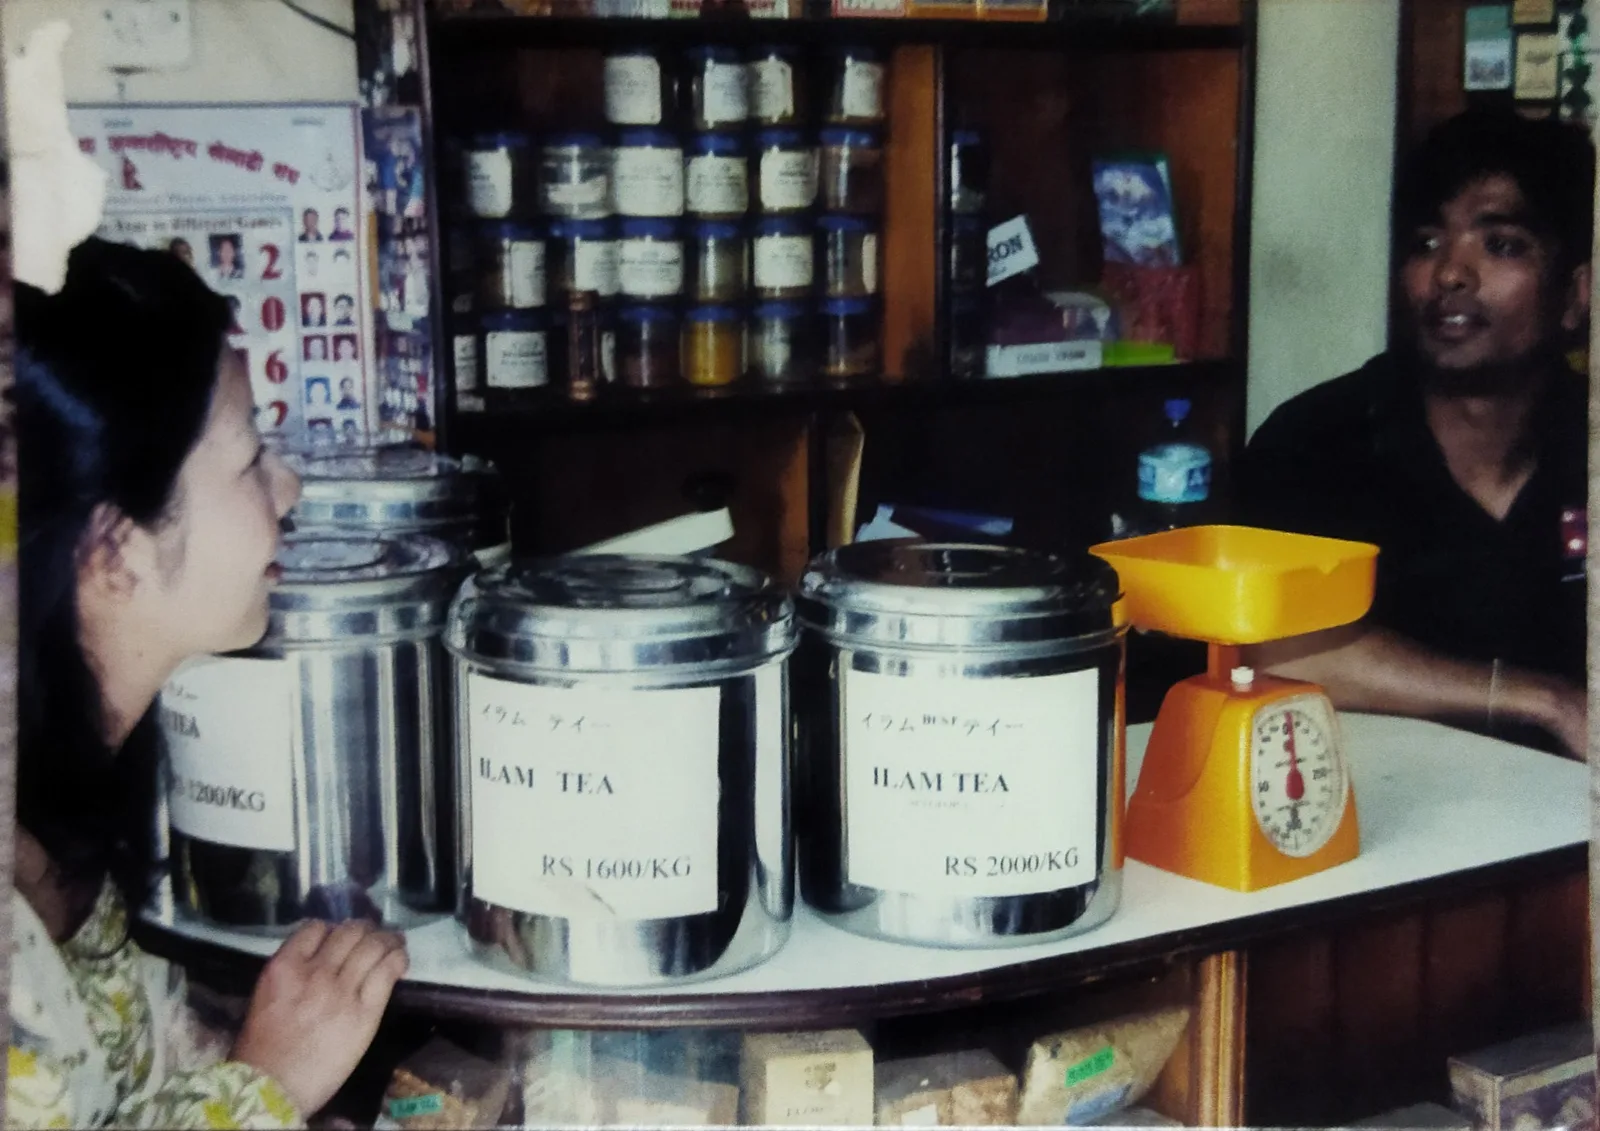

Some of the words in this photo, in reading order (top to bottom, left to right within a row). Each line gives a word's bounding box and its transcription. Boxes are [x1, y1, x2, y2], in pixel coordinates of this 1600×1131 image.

[479, 756, 534, 789] ILAM
[556, 770, 615, 795] TEA
[873, 766, 943, 793] ILAM
[952, 772, 1010, 794] TEA
[541, 854, 575, 878] RS
[586, 855, 692, 880] 1600/KG
[944, 855, 978, 877] RS
[986, 846, 1080, 878] 2000/KG
